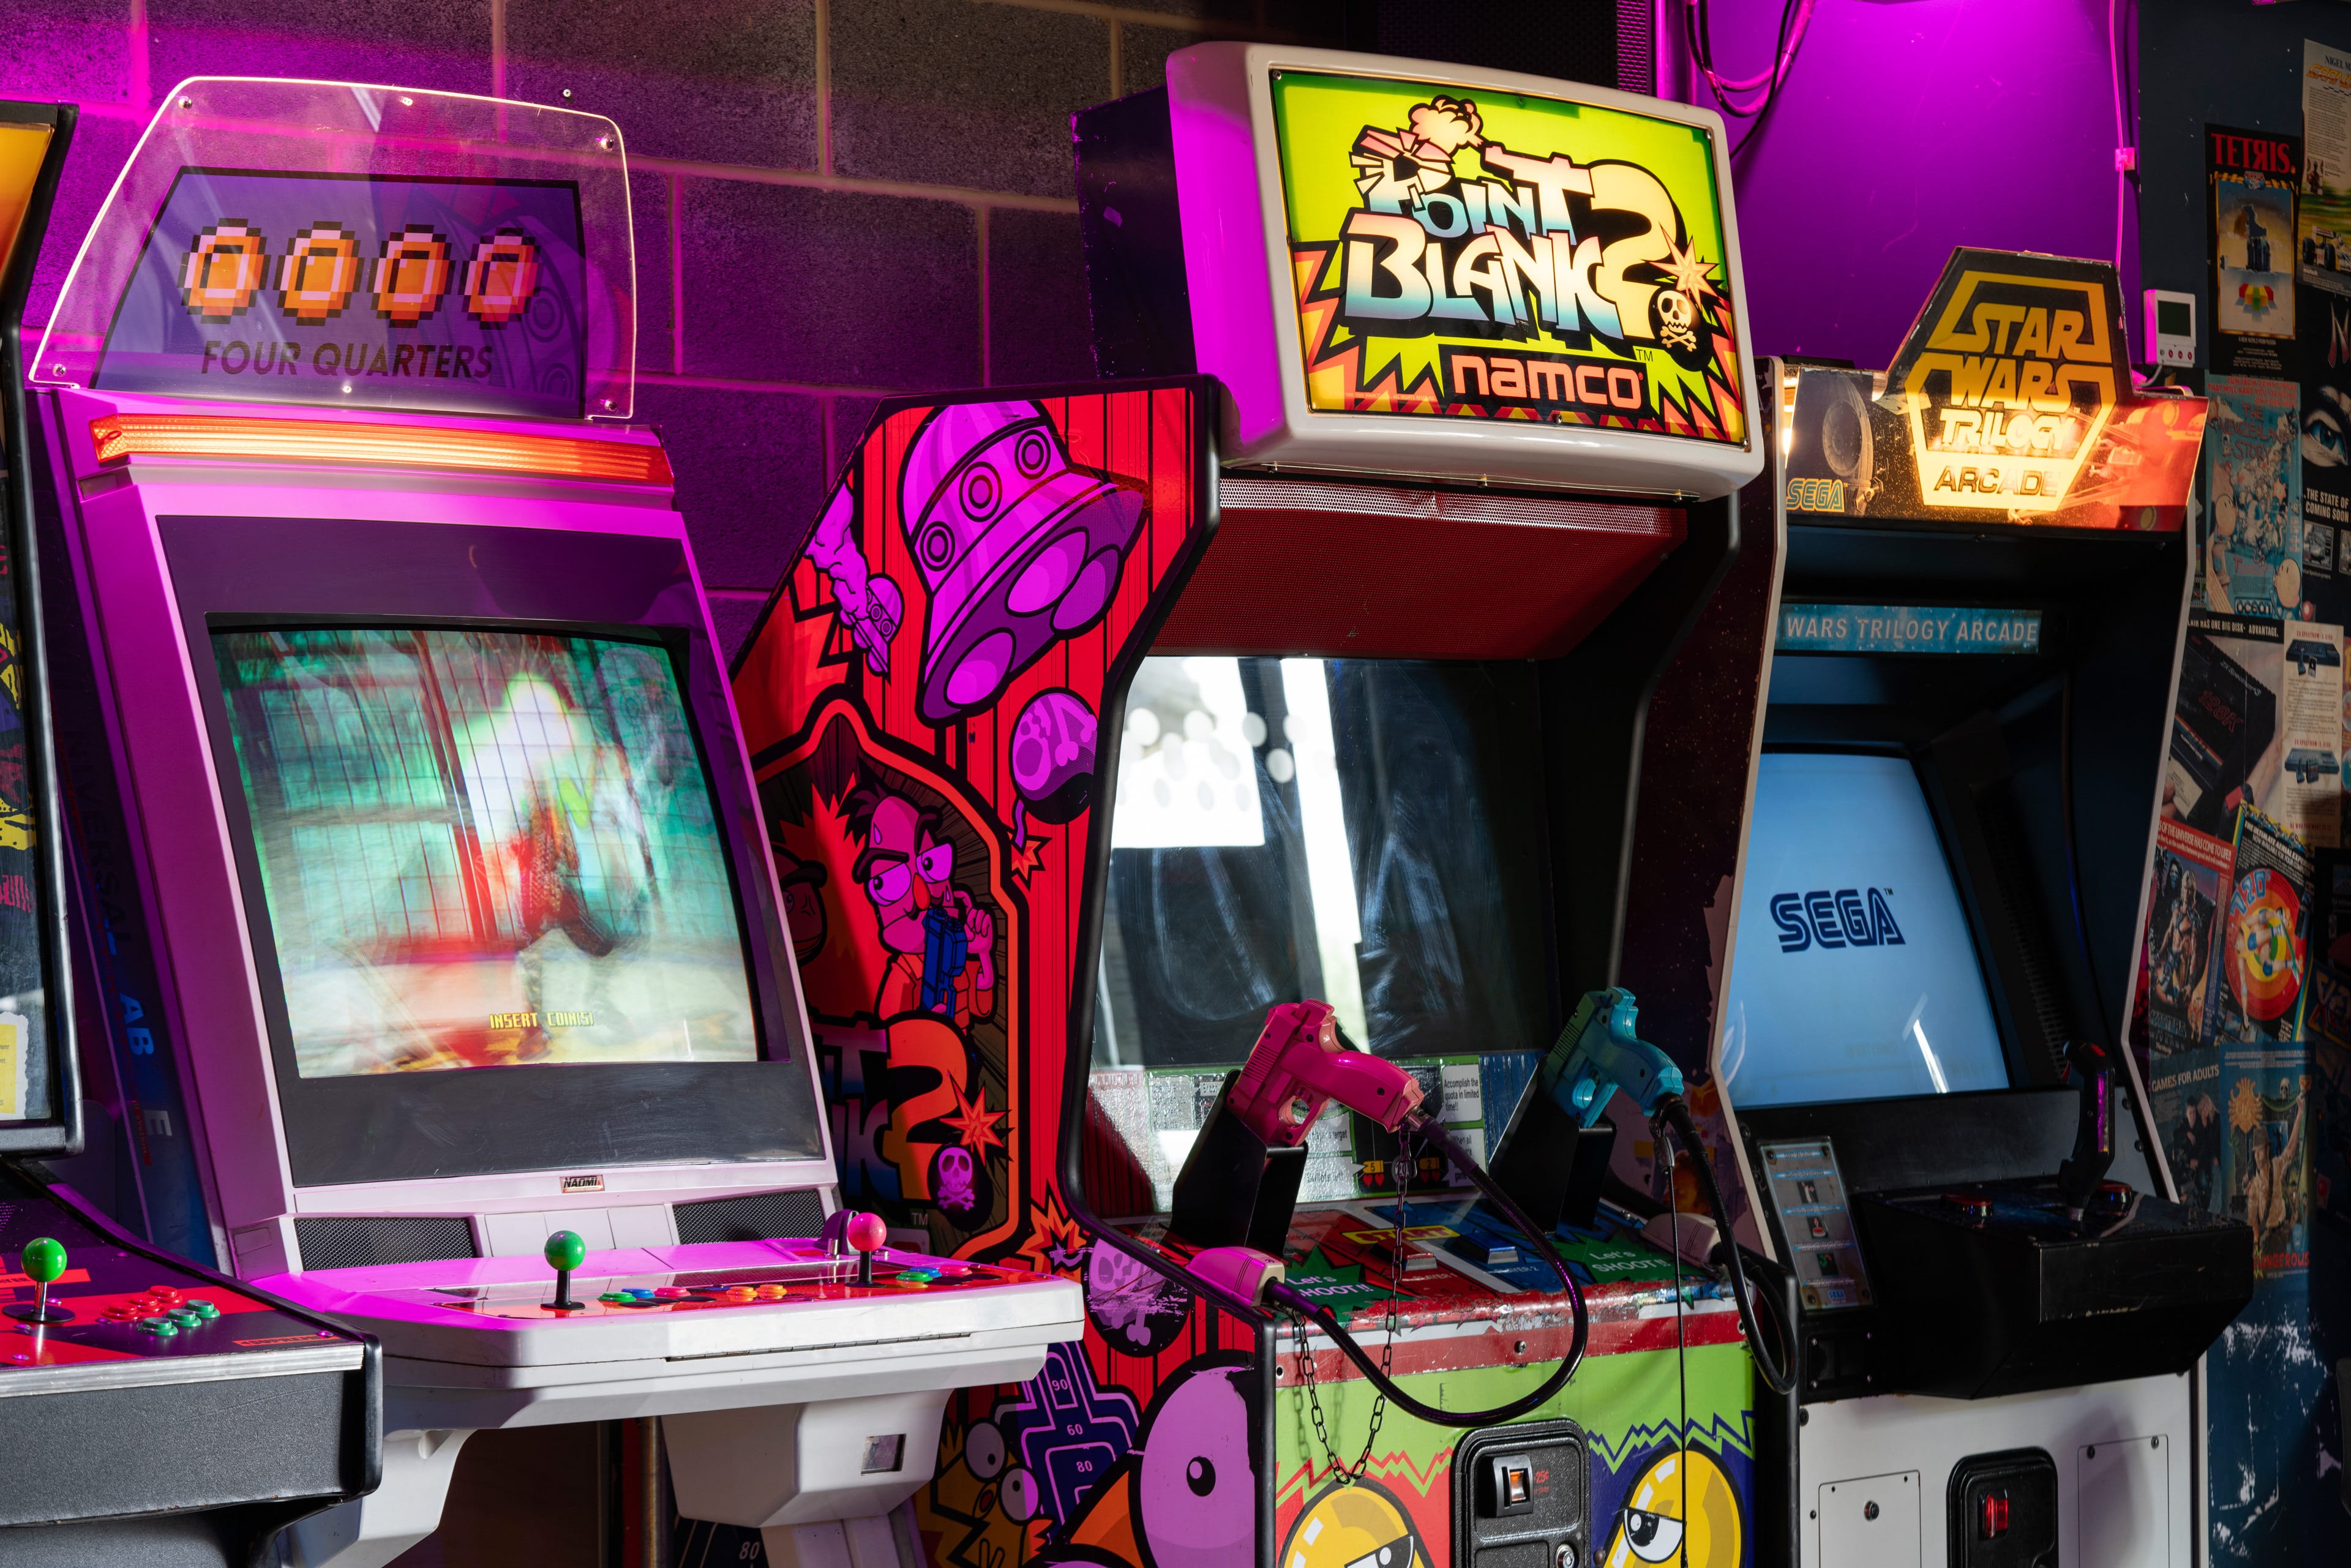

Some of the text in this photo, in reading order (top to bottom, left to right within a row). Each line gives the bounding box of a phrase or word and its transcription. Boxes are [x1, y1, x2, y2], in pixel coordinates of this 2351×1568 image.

[2211, 132, 2290, 174] TETRIS
[1349, 125, 1593, 246] POINT
[1344, 212, 1625, 340] BLANK
[1950, 302, 2094, 361] STAR
[201, 340, 493, 378] FOUR QUARTERS
[1452, 353, 1641, 410] namco
[1944, 353, 2085, 412] WARS
[2241, 404, 2263, 421] THE
[1939, 408, 2077, 451] TRILOGY
[2234, 440, 2271, 460] STORY
[1933, 465, 2061, 497] ARCADE
[1786, 478, 1845, 512] SEGA
[2320, 492, 2339, 507] STATE
[2341, 497, 2350, 509] OF
[2306, 501, 2350, 523] COMING SOON
[1787, 617, 2038, 642] WARS TRILOGY ARCADE
[2200, 619, 2210, 629] HAS
[2211, 618, 2221, 630] ONE
[2222, 620, 2230, 631] BIG
[2198, 689, 2244, 734] 128K
[2175, 827, 2195, 844] UNIVERSE
[2194, 835, 2203, 848] HAS
[2203, 838, 2215, 854] COME
[1769, 887, 1907, 953] SEGA
[490, 1010, 594, 1030] INSERT COIN(S)
[1444, 1079, 1471, 1089] Accomplish
[2151, 1064, 2219, 1092] GAMES FOR ADULTS
[1444, 1091, 1458, 1101] quota
[1464, 1089, 1479, 1098] limited
[1370, 1163, 1376, 1172] 5
[1427, 1159, 1432, 1168] 2
[563, 1177, 598, 1188] NAOMI
[1355, 1226, 1451, 1242] START
[1588, 1251, 1637, 1261] Let's
[1286, 1275, 1337, 1286] Let's
[1051, 1378, 1070, 1394] 90
[1066, 1422, 1084, 1438] 60
[1075, 1458, 1093, 1475] 80
[738, 1540, 762, 1562] 80
